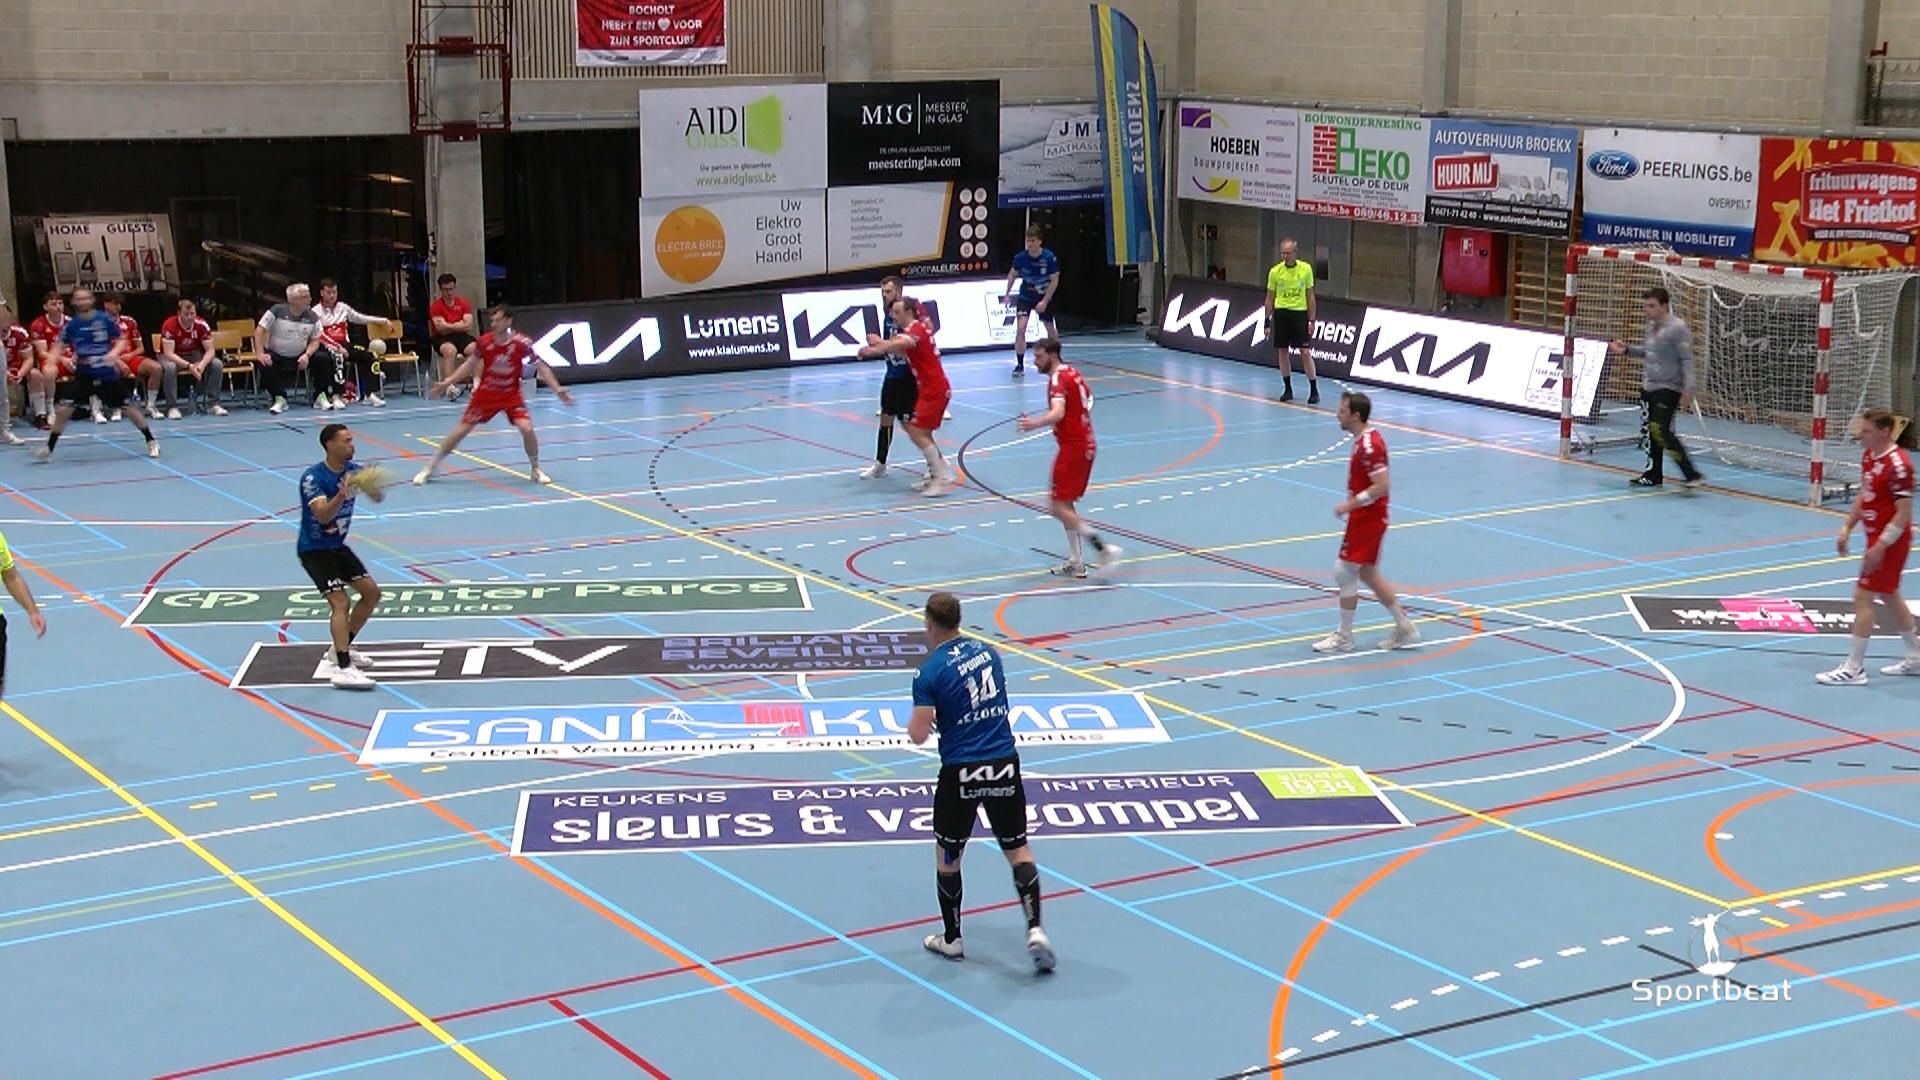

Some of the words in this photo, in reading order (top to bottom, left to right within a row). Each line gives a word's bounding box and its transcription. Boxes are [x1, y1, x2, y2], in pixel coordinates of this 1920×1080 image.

[629, 5, 675, 15] BOCHOLT
[602, 20, 633, 31] HEEFT
[635, 20, 656, 30] EEN
[673, 20, 702, 30] VOOR
[633, 35, 695, 46] SPORTCLUBS
[861, 104, 913, 125] MIG
[925, 101, 967, 113] MEESTER
[685, 107, 738, 136] AID
[925, 114, 935, 124] IN
[937, 113, 963, 124] GLAS
[1304, 113, 1422, 131] BOUWONDERNEMING
[1046, 142, 1101, 157] MATRASS
[1210, 136, 1260, 156] HOEBEN
[1434, 130, 1524, 150] AUTOVERHUUR
[1526, 136, 1572, 153] BROEKX
[1336, 127, 1410, 181] BEKO
[868, 156, 961, 171] meesteringlas.com
[1194, 156, 1259, 174] bouwprojecten
[1597, 154, 1629, 177] Ford
[1643, 160, 1752, 183] PEERLINGS.be
[695, 172, 777, 187] www.aidglass.be
[1437, 163, 1470, 187] HUUR
[1472, 161, 1492, 185] MIJ
[1312, 174, 1349, 187] SLEUTEL
[1351, 178, 1366, 188] OP
[1367, 179, 1380, 189] DE
[1383, 181, 1410, 192] DEUR
[1809, 172, 1917, 195] frituurwagens
[781, 199, 801, 212] Uw
[1297, 203, 1350, 216] www.beko.be
[1708, 197, 1752, 210] OVERPELT
[1808, 198, 1841, 222] Het
[1843, 198, 1917, 224] Frietkot
[49, 225, 91, 235] HOME
[106, 223, 156, 233] GUESTS
[756, 216, 802, 231] Elektro
[765, 231, 802, 247] Groot
[1597, 223, 1612, 236] UW
[1613, 225, 1660, 240] PARTNER
[1661, 229, 1673, 241] IN
[1674, 231, 1736, 247] MOBILITEIT
[656, 240, 697, 253] ELECTRA
[81, 252, 96, 272] 4
[755, 248, 802, 264] Handel
[1312, 319, 1357, 345] mens
[689, 342, 781, 359] www.kialumens.be
[575, 581, 788, 598] Parcs
[284, 603, 514, 617] Errheide
[663, 633, 909, 648] BRILJANT
[661, 643, 929, 661] BEVEILIGD
[957, 650, 993, 677] SPOOREN
[965, 665, 998, 710] 14
[430, 746, 560, 758] Centrale
[571, 742, 755, 756] Verwarming
[553, 790, 727, 807] KEUKENS
[772, 785, 937, 801] BADKAM
[1041, 775, 1235, 792] INTERIEUR
[1279, 778, 1358, 795] 1934
[550, 810, 775, 843] sleurs
[798, 803, 847, 836] &
